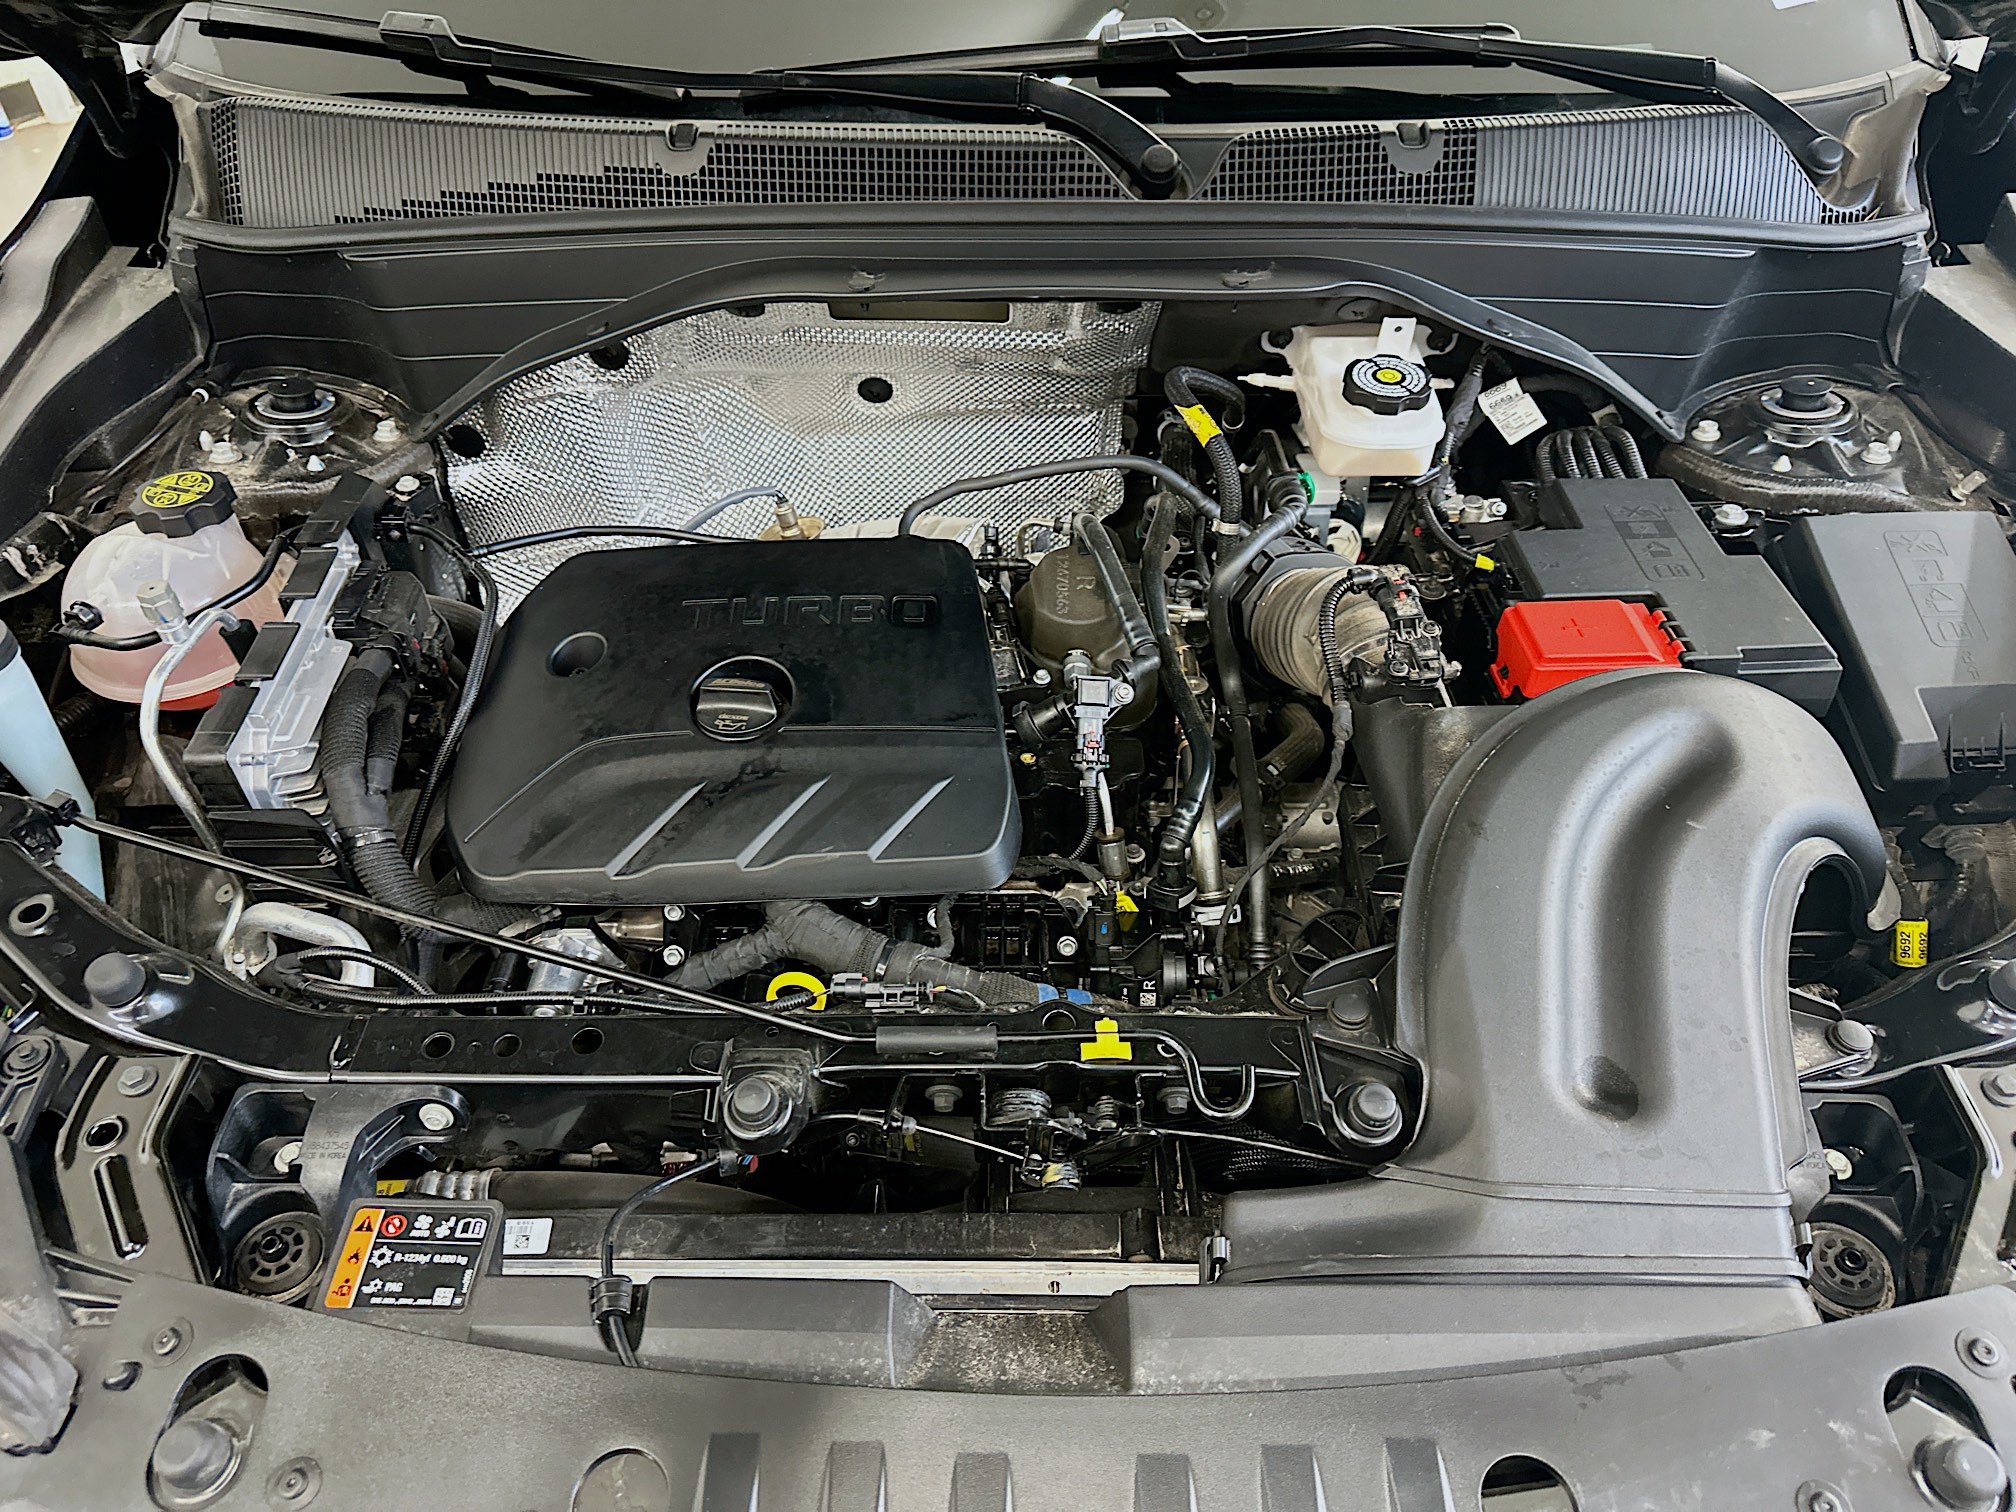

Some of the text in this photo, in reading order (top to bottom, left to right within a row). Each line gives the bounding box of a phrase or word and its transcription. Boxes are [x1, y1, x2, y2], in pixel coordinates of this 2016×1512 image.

[1076, 576, 1096, 590] R
[682, 595, 939, 629] TURBO
[1900, 931, 1911, 959] 9692
[1143, 980, 1156, 990] R
[384, 1281, 404, 1292] PAG
